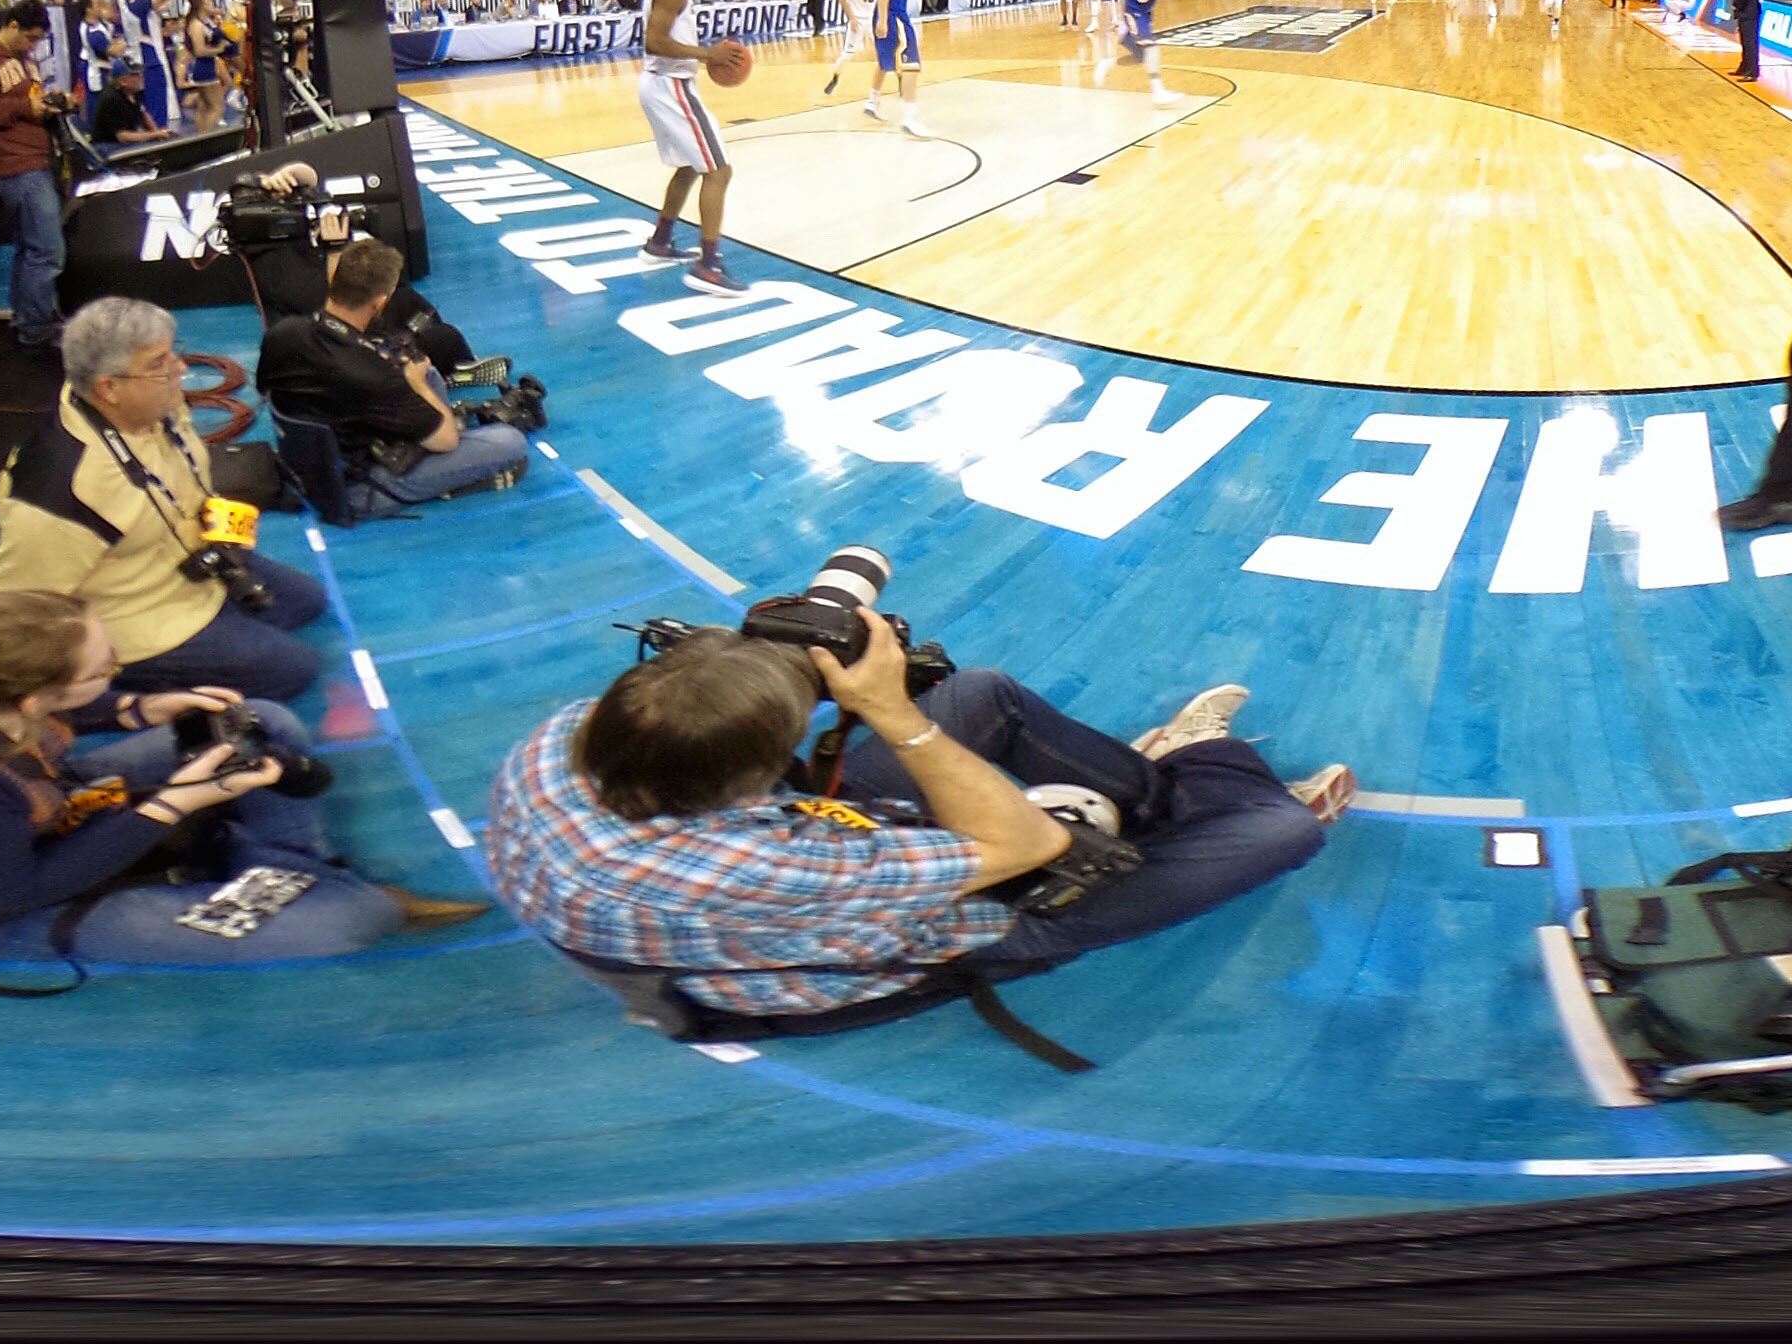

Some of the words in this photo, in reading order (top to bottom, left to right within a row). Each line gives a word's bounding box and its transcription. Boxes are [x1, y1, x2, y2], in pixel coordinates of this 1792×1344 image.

[533, 20, 621, 54] FIRST
[696, 5, 786, 40] SECOND
[415, 159, 600, 224] THE
[499, 218, 703, 294] TO
[616, 281, 1271, 539] ROAD
